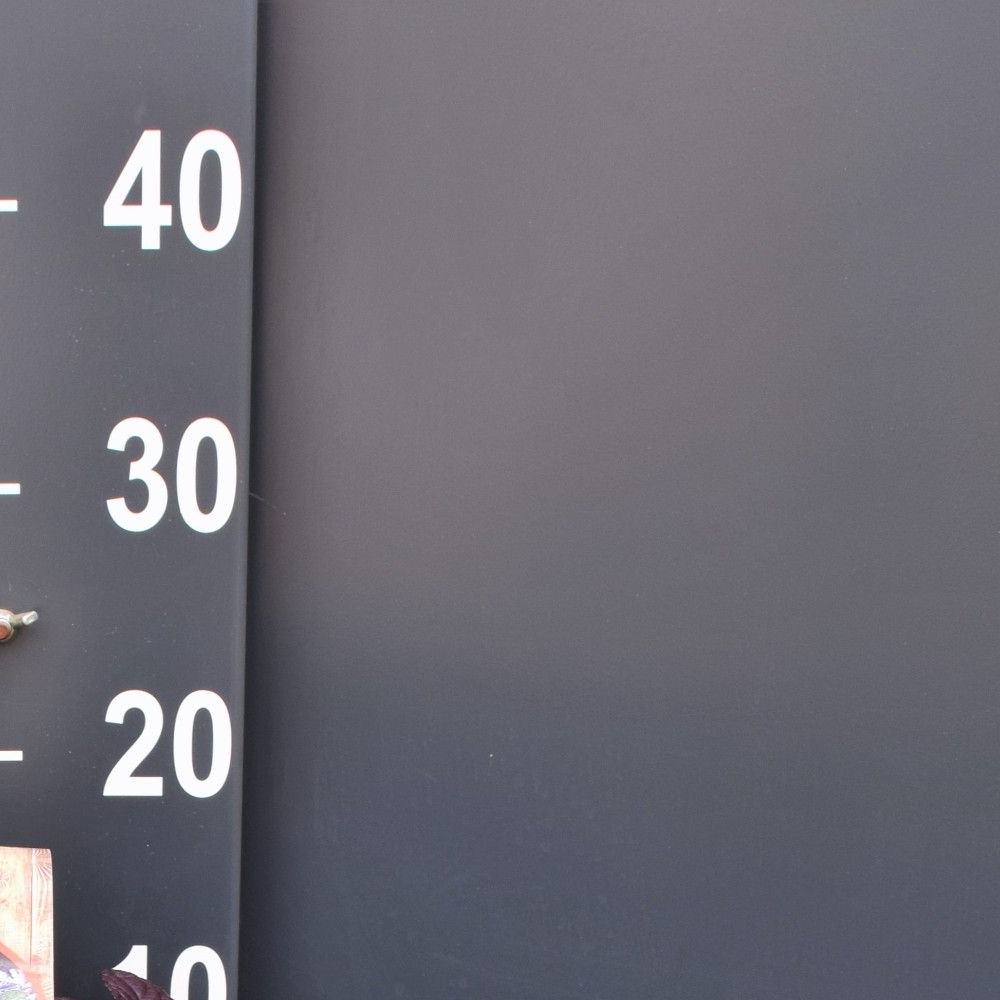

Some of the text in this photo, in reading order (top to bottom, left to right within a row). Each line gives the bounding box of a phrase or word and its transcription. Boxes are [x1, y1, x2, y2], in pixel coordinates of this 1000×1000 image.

[102, 128, 243, 252] 40
[106, 416, 238, 534] 30
[102, 689, 233, 799] 20
